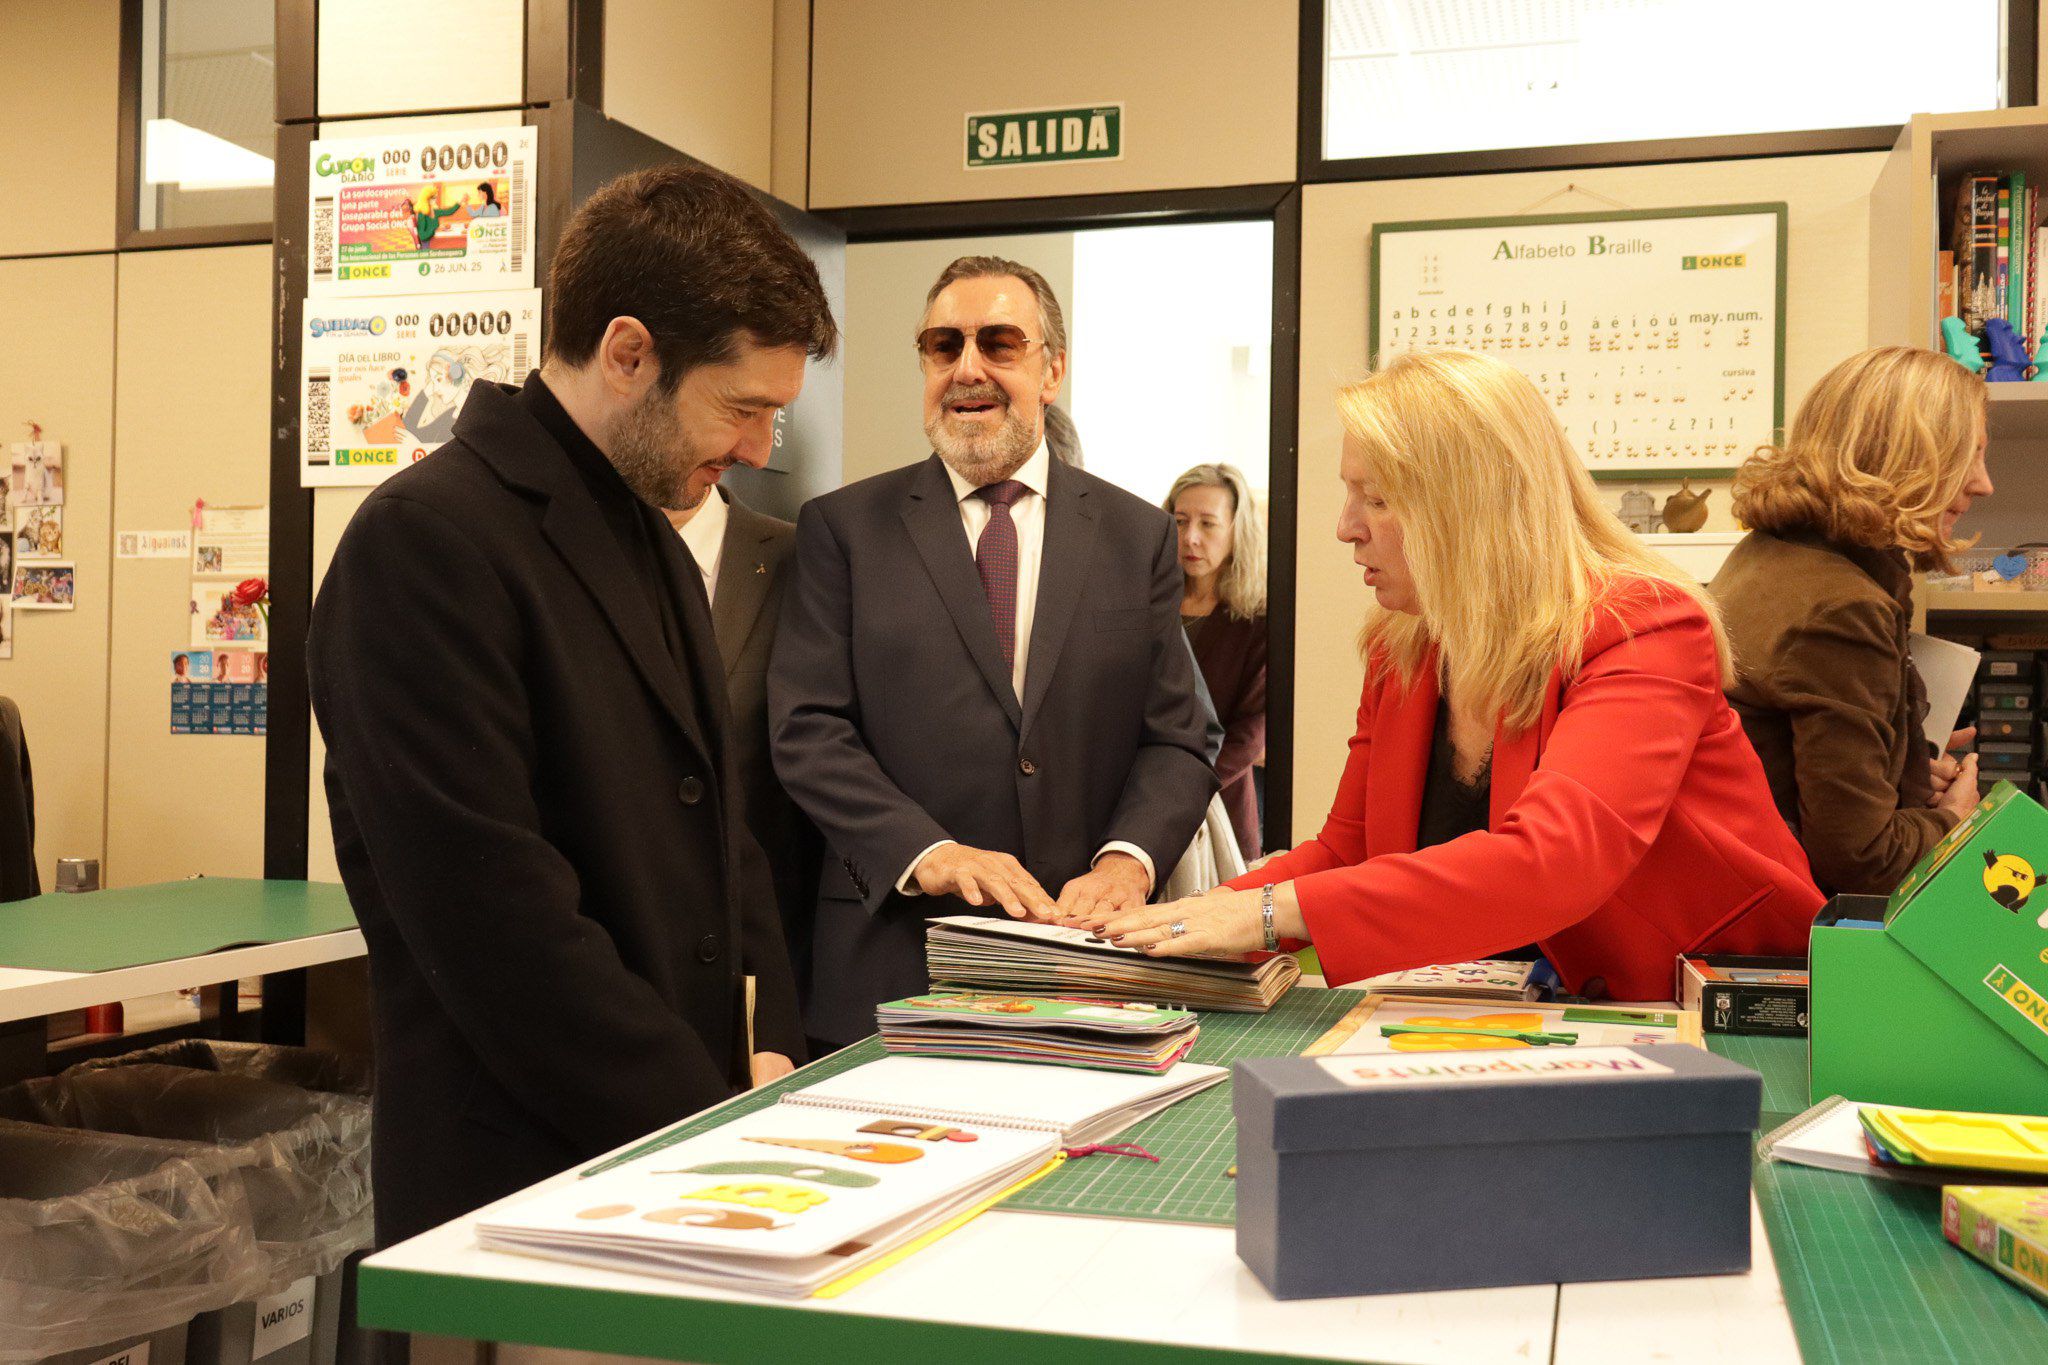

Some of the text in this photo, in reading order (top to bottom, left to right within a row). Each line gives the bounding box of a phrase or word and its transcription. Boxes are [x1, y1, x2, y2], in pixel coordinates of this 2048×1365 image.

[978, 115, 1109, 158] SALIDA
[383, 140, 508, 172] 000 00000
[341, 190, 351, 199] La
[341, 200, 380, 211] una parte
[341, 208, 404, 221] inseparable del
[341, 222, 365, 232] Grupo
[366, 219, 390, 230] Social
[1492, 235, 1653, 261] Alfabeto Braille
[434, 263, 446, 273] 26
[471, 261, 482, 272] 25
[1700, 255, 1743, 268] ONCE
[352, 265, 388, 278] ONCE
[522, 309, 533, 320] 2€
[1393, 301, 1567, 319] a b c d e f g h i j
[396, 310, 511, 337] 000 00000
[1592, 310, 1763, 329] á é í ó ú may. num.
[397, 330, 416, 339] SERIE
[1393, 320, 1568, 338] 1 2 3 4 5 6 7 8 9 0
[373, 352, 401, 362] LIBRO
[1541, 371, 1566, 382] s t
[1722, 368, 1756, 378] cursiva
[353, 450, 394, 463] ONCE
[1353, 1058, 1645, 1080] Maripoints
[261, 1299, 305, 1330] VARIOS
